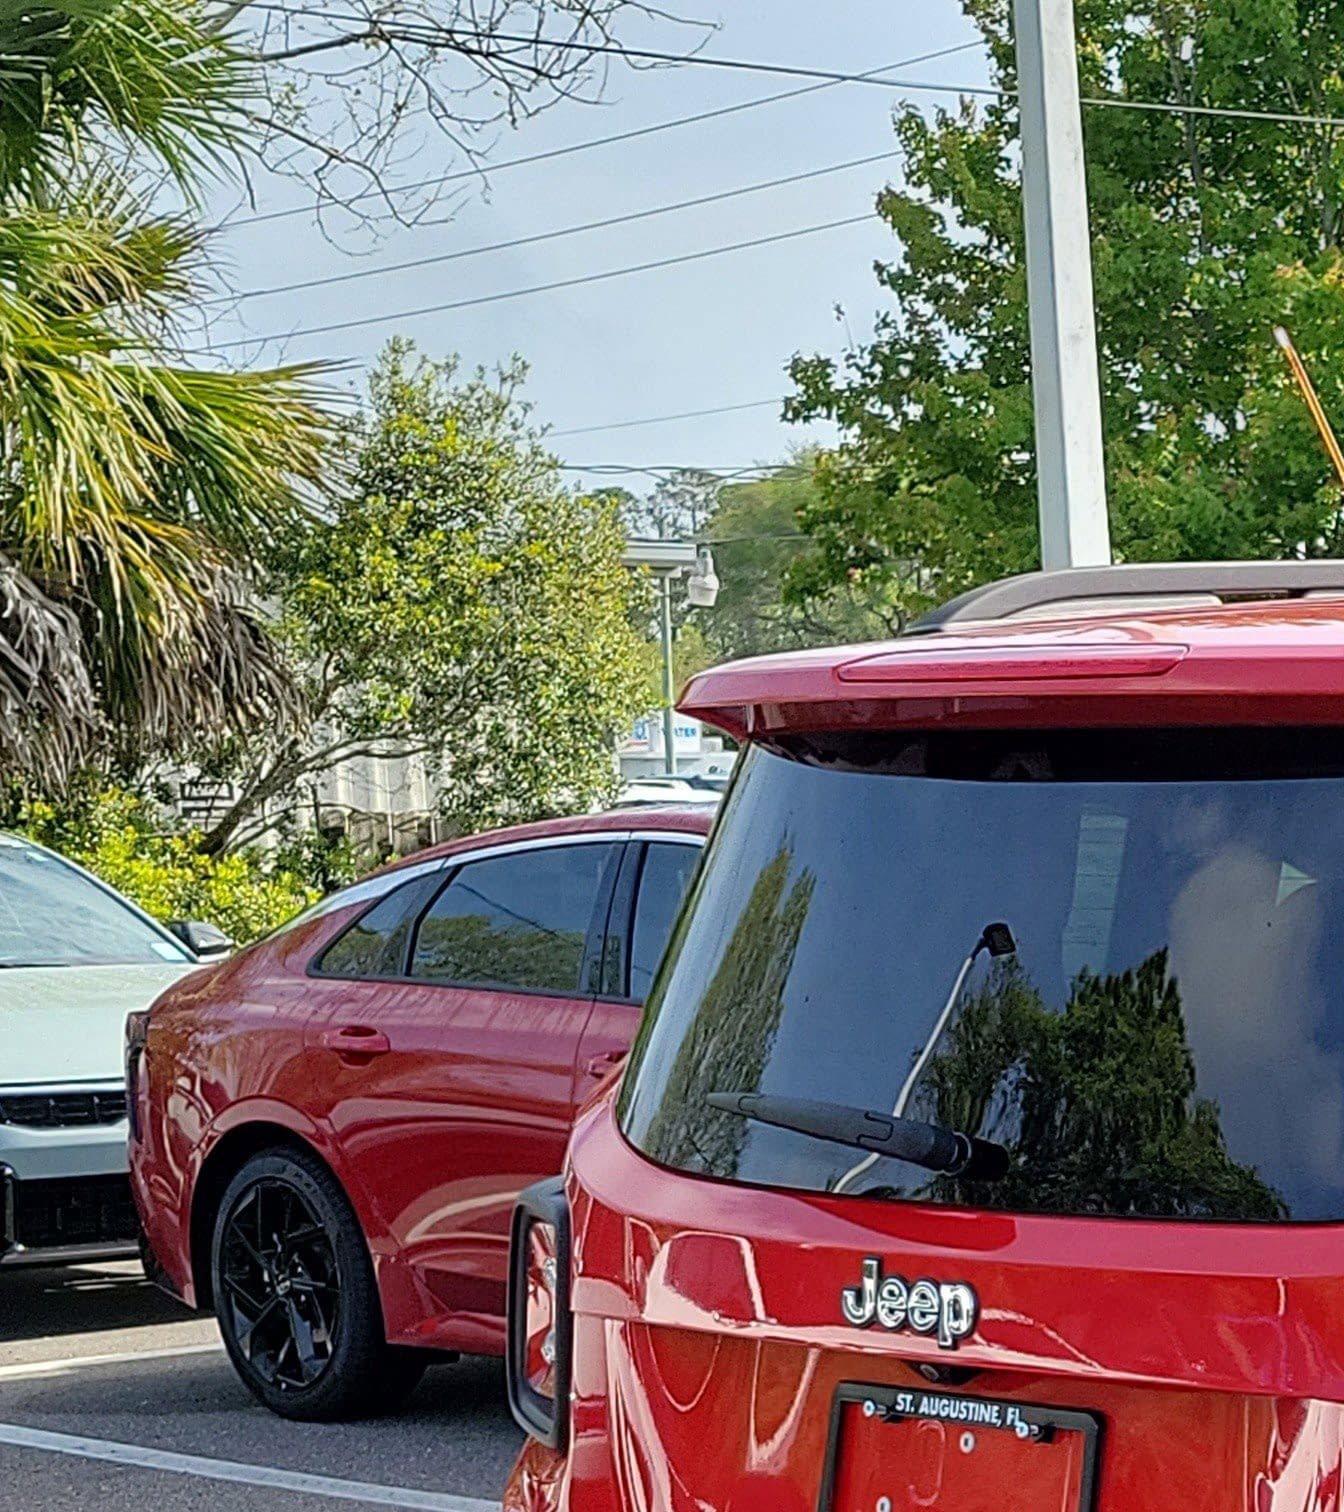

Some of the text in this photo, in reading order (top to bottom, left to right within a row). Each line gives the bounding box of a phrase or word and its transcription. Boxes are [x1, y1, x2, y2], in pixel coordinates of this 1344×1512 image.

[842, 1256, 979, 1350] Jeep
[894, 1392, 1022, 1427] ST. AUGUSTINE, FL
